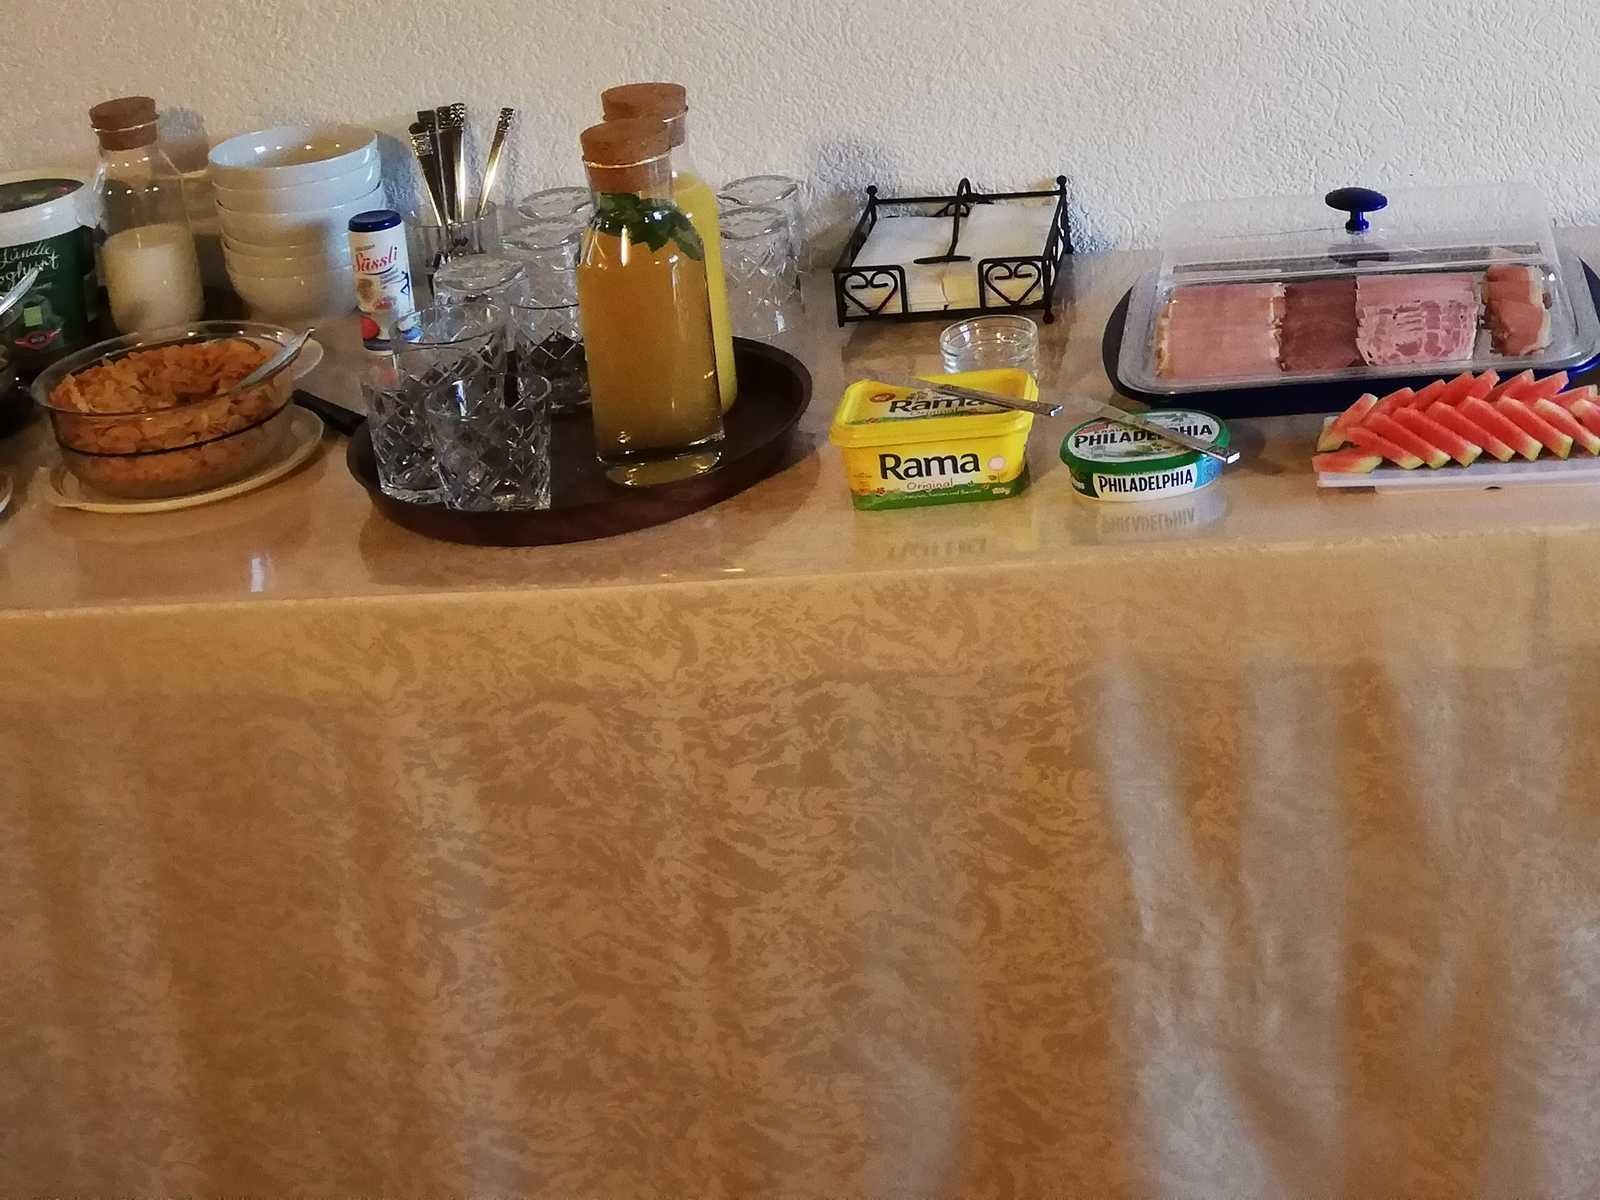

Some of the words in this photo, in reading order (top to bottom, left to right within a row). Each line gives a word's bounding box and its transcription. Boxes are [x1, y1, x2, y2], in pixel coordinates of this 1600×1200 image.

[889, 397, 987, 414] Rama
[878, 452, 981, 482] Rama
[906, 477, 954, 493] Original
[1098, 468, 1194, 494] PHILADELPHIA
